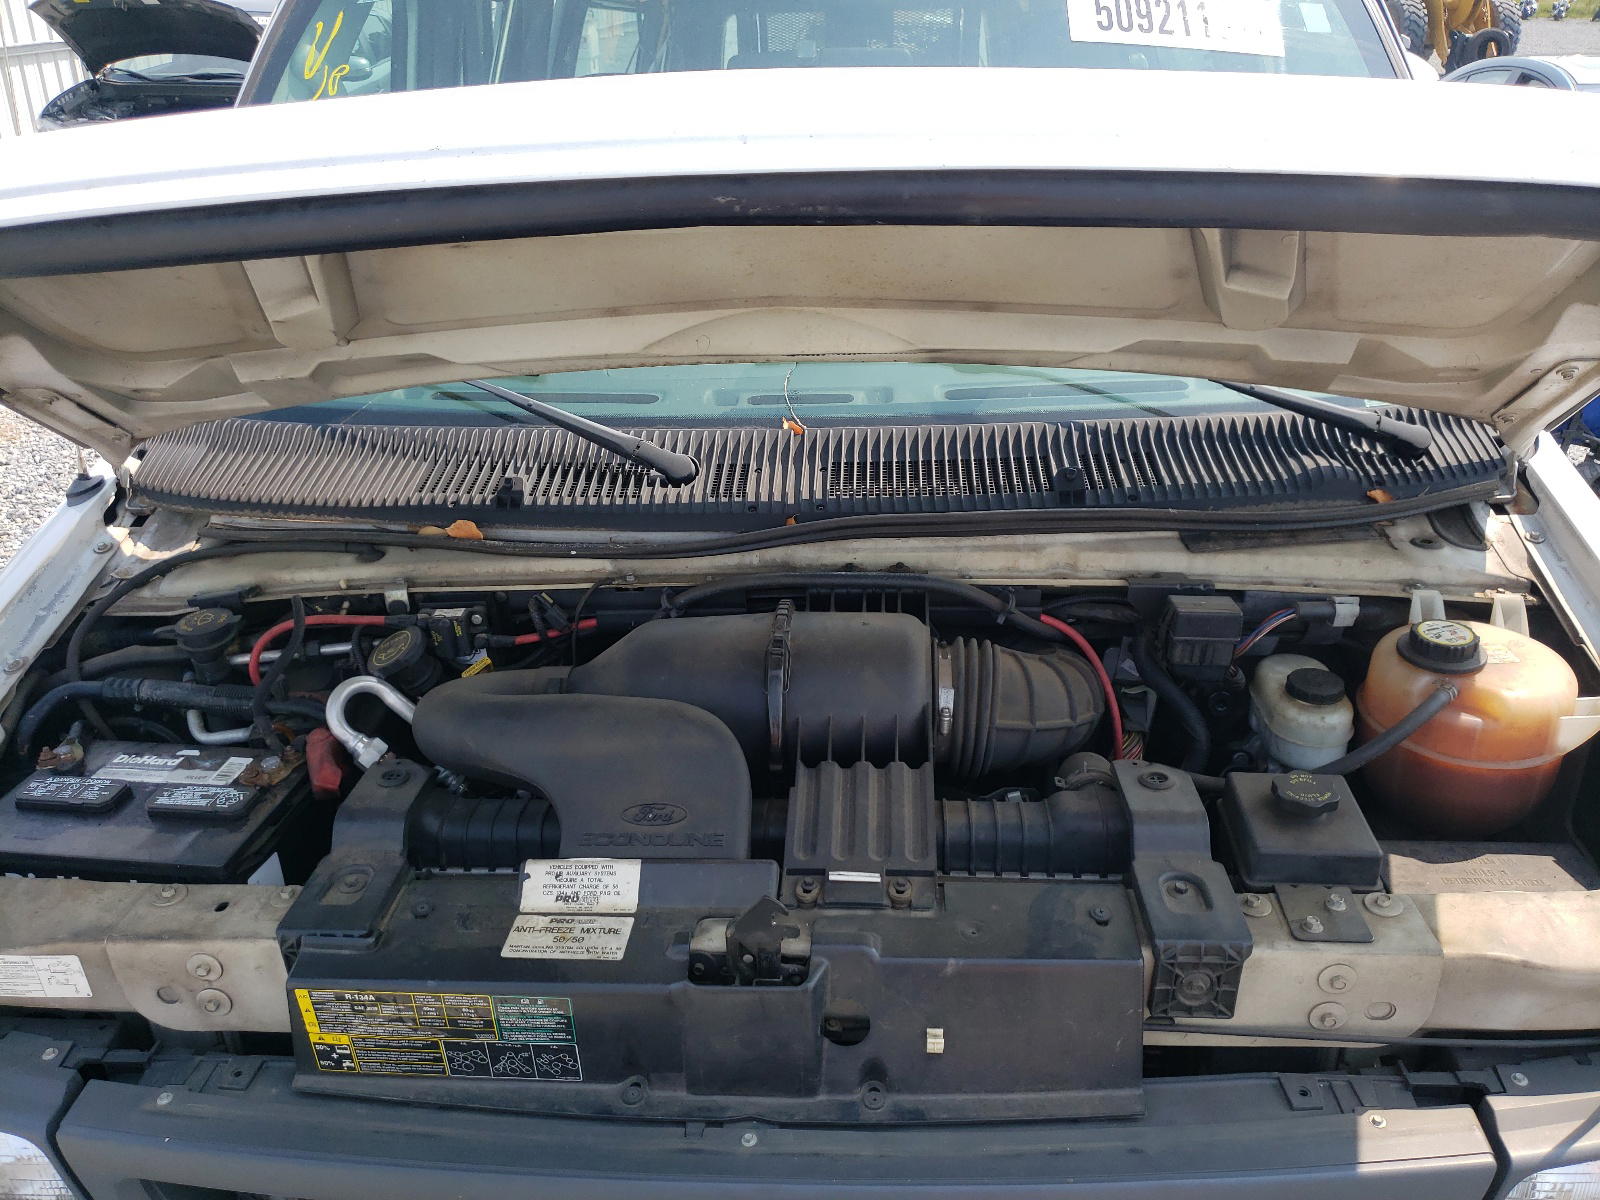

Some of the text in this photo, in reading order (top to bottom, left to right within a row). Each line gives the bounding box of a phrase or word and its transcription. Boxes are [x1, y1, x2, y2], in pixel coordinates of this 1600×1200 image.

[112, 754, 185, 766] DieHard
[632, 805, 675, 822] Ford
[512, 926, 623, 935] ANTI-FREEZE MIXTURE
[552, 936, 585, 944] 50/50
[345, 993, 376, 1001] R-134A
